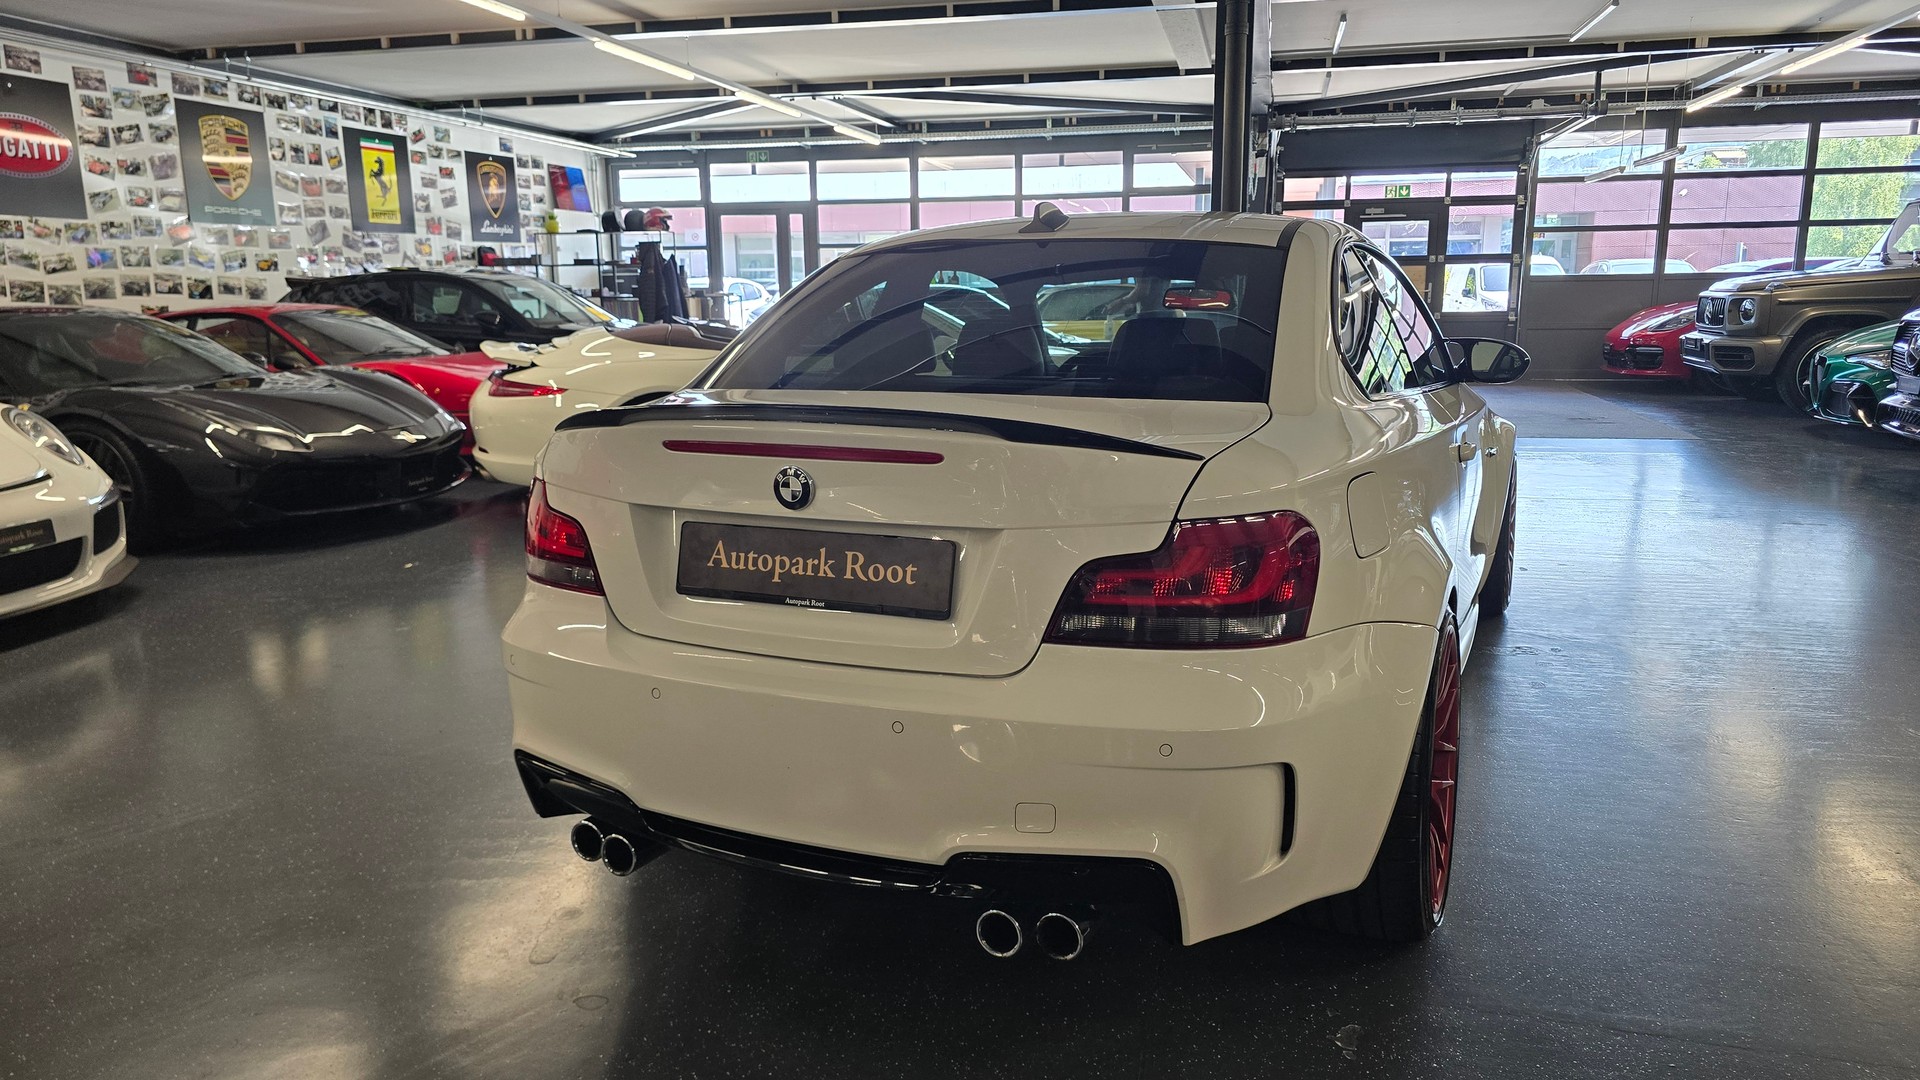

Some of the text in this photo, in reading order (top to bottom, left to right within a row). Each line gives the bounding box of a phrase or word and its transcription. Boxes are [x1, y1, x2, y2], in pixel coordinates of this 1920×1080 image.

[0, 136, 61, 161] GATTI
[205, 205, 262, 217] PORSCHE
[776, 468, 807, 484] BMW
[707, 540, 918, 585] Autopark Root
[784, 597, 825, 607] Autopark Root
